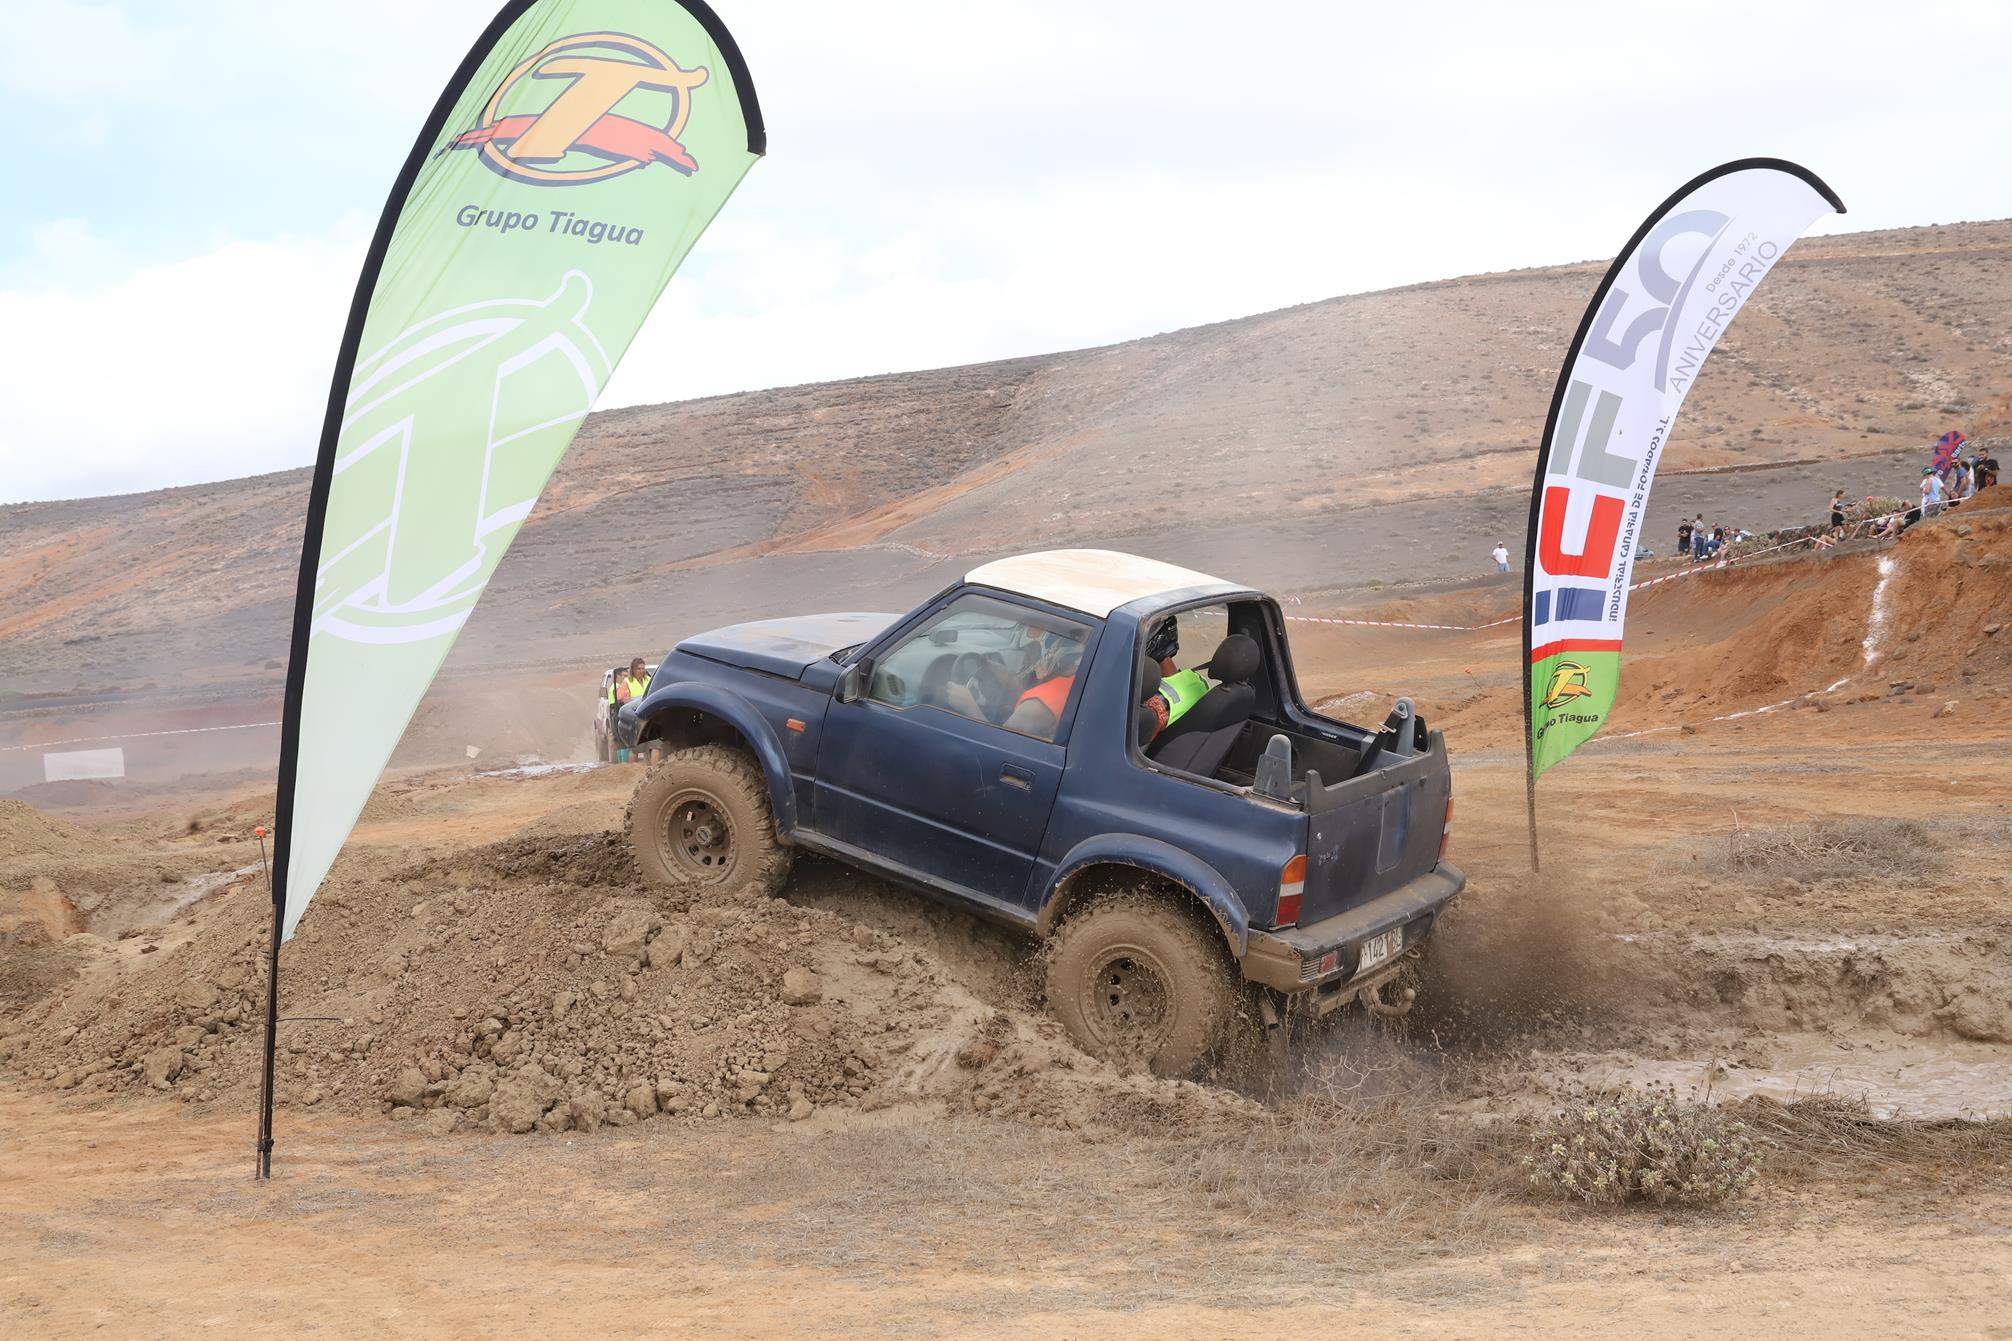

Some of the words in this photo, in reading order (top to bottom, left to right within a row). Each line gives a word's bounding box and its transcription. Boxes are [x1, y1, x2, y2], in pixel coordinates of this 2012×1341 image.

[456, 204, 539, 233] Grupo
[549, 210, 644, 244] Tiagua
[1705, 257, 1736, 293] Desde
[1734, 231, 1758, 256] 1972
[1670, 241, 1777, 393] ANIVERSARIO
[1631, 493, 1643, 508] DE
[1637, 435, 1660, 491] FORJADOS
[1558, 713, 1599, 724] Tiagua
